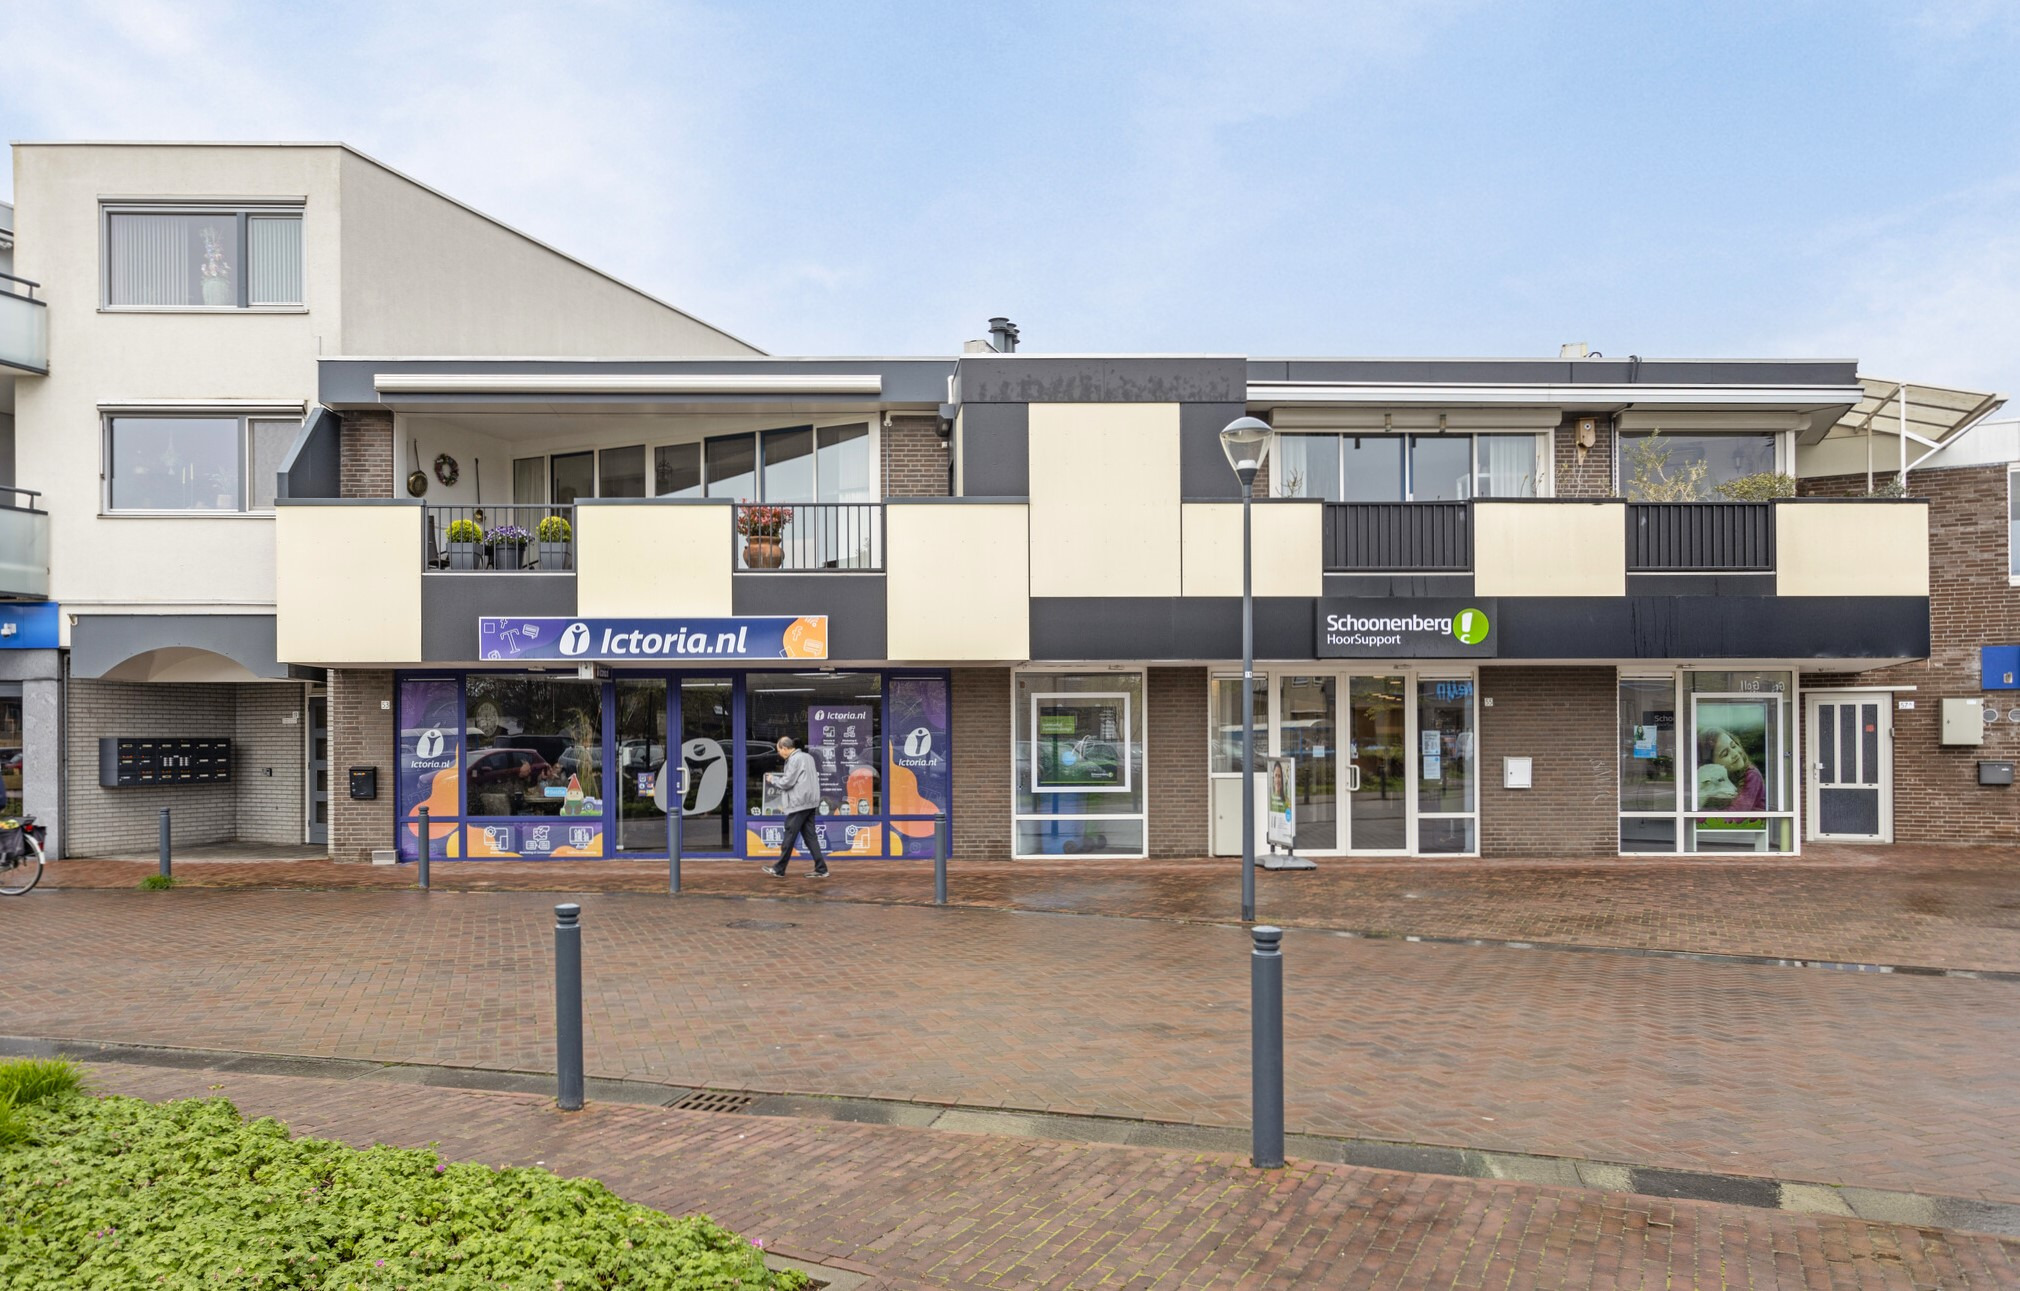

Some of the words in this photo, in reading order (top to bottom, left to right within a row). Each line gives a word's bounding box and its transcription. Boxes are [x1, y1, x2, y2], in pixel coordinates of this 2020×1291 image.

[1327, 614, 1452, 635] Schoonenberg
[600, 626, 748, 654] Ictoria.nl
[1327, 633, 1401, 647] HoorSupport
[827, 711, 866, 720] Ictoria.nl
[411, 760, 450, 768] Ictoria.nl
[898, 758, 937, 766] Ictoria.nl
